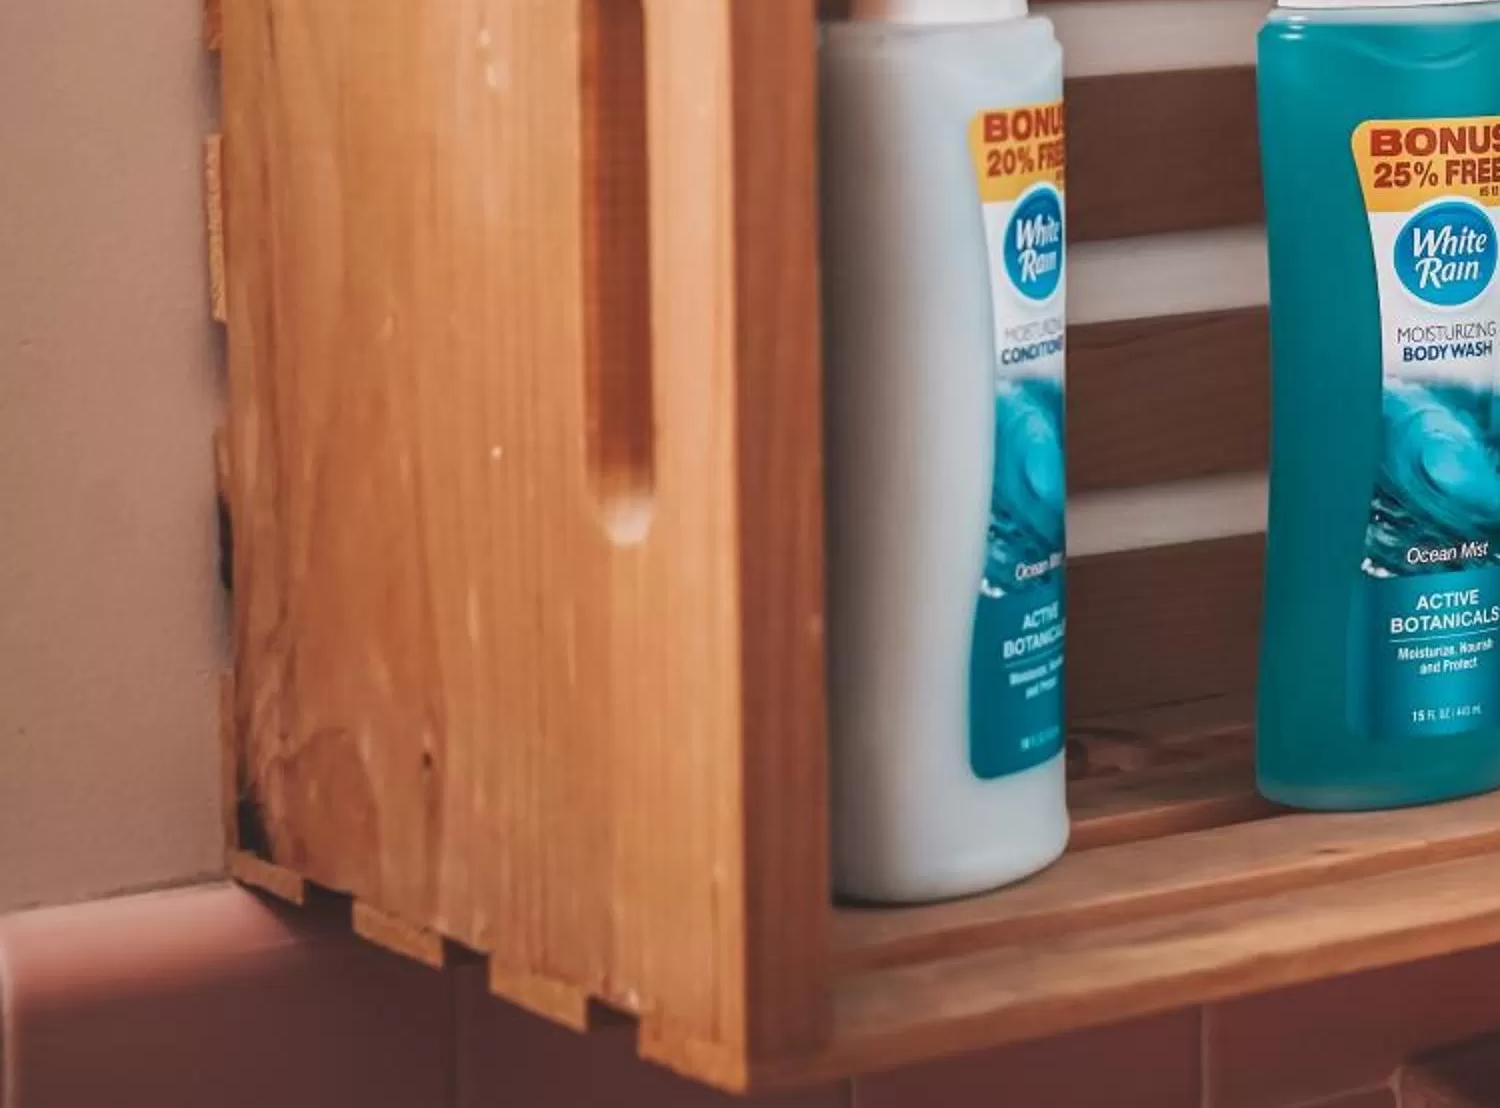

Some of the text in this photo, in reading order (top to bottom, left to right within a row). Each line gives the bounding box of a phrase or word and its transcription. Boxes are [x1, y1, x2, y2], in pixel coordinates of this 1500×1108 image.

[986, 143, 1035, 179] 20%
[1373, 161, 1439, 189] 25%
[1016, 213, 1061, 250] White
[1411, 225, 1488, 258] White
[1415, 256, 1480, 289] Rain
[1397, 321, 1497, 344] MOISTURIZING
[1403, 341, 1493, 362] BODY WASH
[1407, 541, 1489, 565] Ocean Mist
[1416, 589, 1480, 611] ACTIVE
[1420, 656, 1478, 676] and Protect
[1412, 709, 1425, 723] 15
